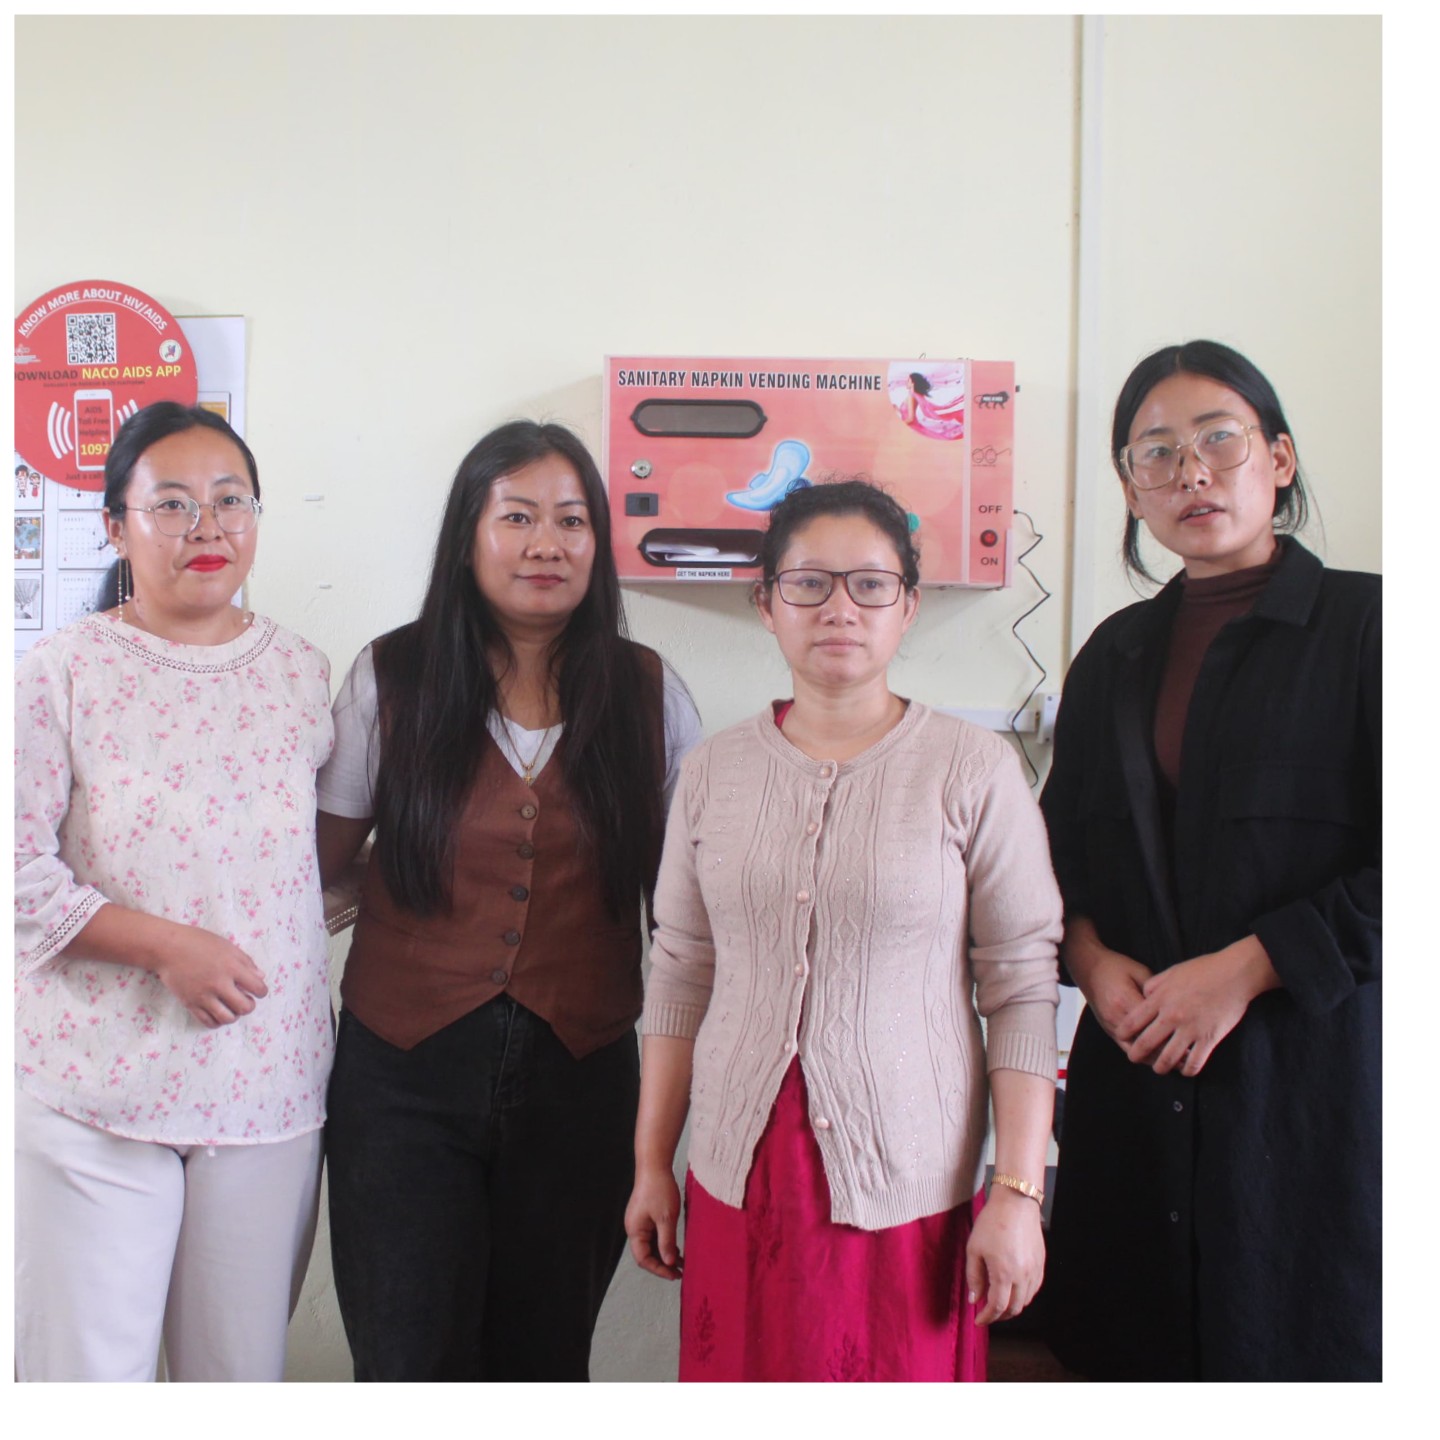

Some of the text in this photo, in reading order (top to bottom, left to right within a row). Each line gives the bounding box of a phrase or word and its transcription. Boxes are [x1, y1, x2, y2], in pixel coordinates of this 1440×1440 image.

[18, 288, 169, 338] KNOW MORE ABOUT HIV/AIDS
[82, 366, 120, 380] NACO
[122, 365, 153, 378] AIDS
[156, 364, 182, 377] APP
[618, 370, 882, 391] SANITARY NAPKIN VENDING MACHINE
[84, 406, 103, 414] AIDS
[93, 417, 109, 425] Free
[80, 443, 110, 456] 1097
[978, 504, 1003, 514] OFF
[980, 556, 999, 566] ON
